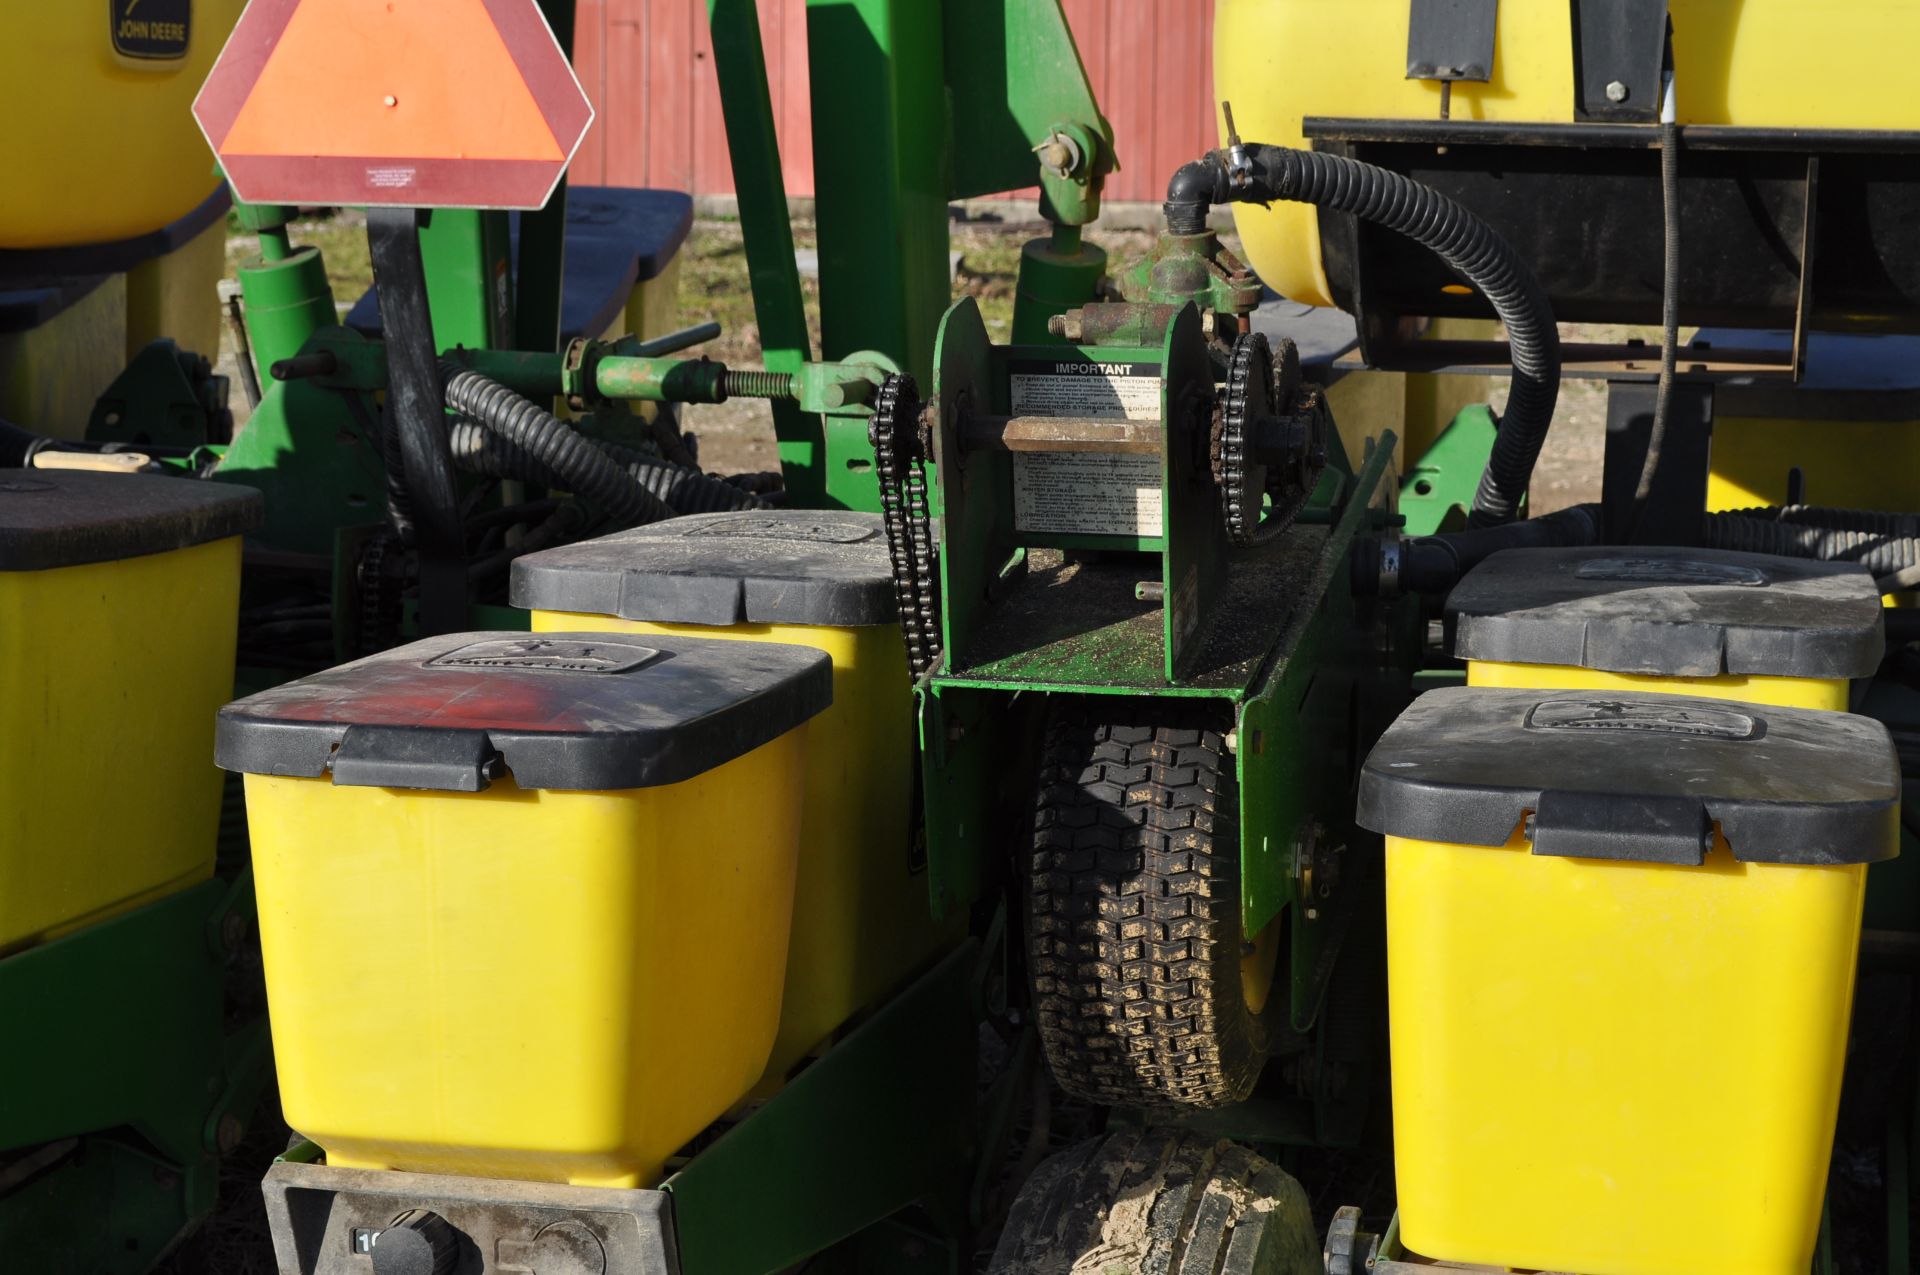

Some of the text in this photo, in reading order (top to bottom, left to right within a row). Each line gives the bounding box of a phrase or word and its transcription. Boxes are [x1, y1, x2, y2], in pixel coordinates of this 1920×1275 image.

[118, 20, 185, 41] JOHN DEERE
[1056, 363, 1132, 375] IMPORTANT
